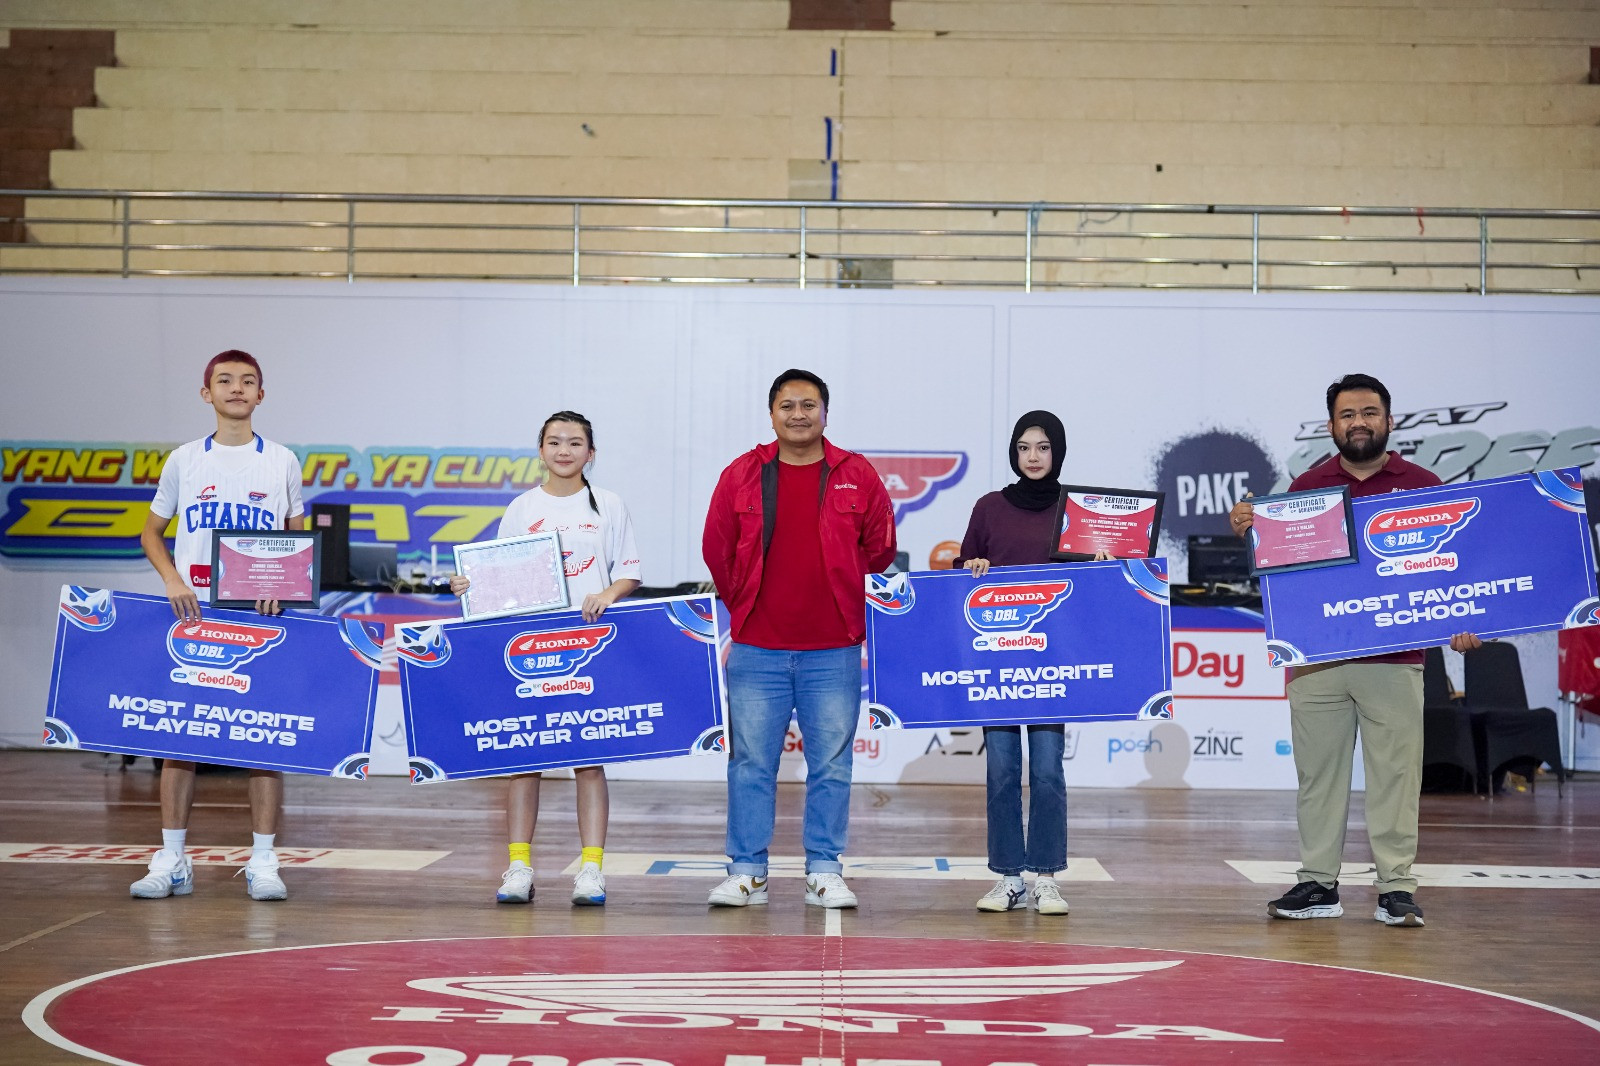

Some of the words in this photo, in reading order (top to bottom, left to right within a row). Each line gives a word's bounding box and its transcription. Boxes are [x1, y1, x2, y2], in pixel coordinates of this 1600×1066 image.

[2, 448, 127, 483] YANG
[371, 455, 432, 487] YA
[1104, 496, 1140, 505] CERTIFICATE
[1288, 498, 1326, 509] CERTIFICATE
[185, 501, 275, 534] CHARIS
[1395, 513, 1453, 527] HONDA
[259, 539, 296, 547] CERTIFICATE
[1397, 531, 1426, 546] DBL
[993, 592, 1047, 603] HONDA
[1322, 593, 1399, 618] MOST
[1408, 575, 1534, 607] FAVORITE
[994, 608, 1020, 622] DBL
[1374, 600, 1486, 628] SCHOOL
[200, 629, 257, 643] HONDA
[535, 637, 590, 650] HONDA
[197, 644, 225, 659] DBL
[536, 654, 564, 669] DBL
[921, 669, 991, 686] MOST
[999, 663, 1114, 683] FAVORITE
[1172, 641, 1245, 689] Day
[968, 683, 1067, 702] DANCER
[108, 693, 186, 716] MOST
[193, 703, 315, 732] FAVORITE
[463, 715, 538, 736] MOST
[545, 702, 664, 728] FAVORITE
[122, 713, 221, 738] PLAYER
[228, 725, 297, 747] BOYS
[476, 729, 572, 751] PLAYER
[580, 720, 654, 741] GIRLS
[1108, 730, 1162, 763] posh
[1193, 732, 1243, 756] ZINC
[371, 1005, 1285, 1042] HONDA
